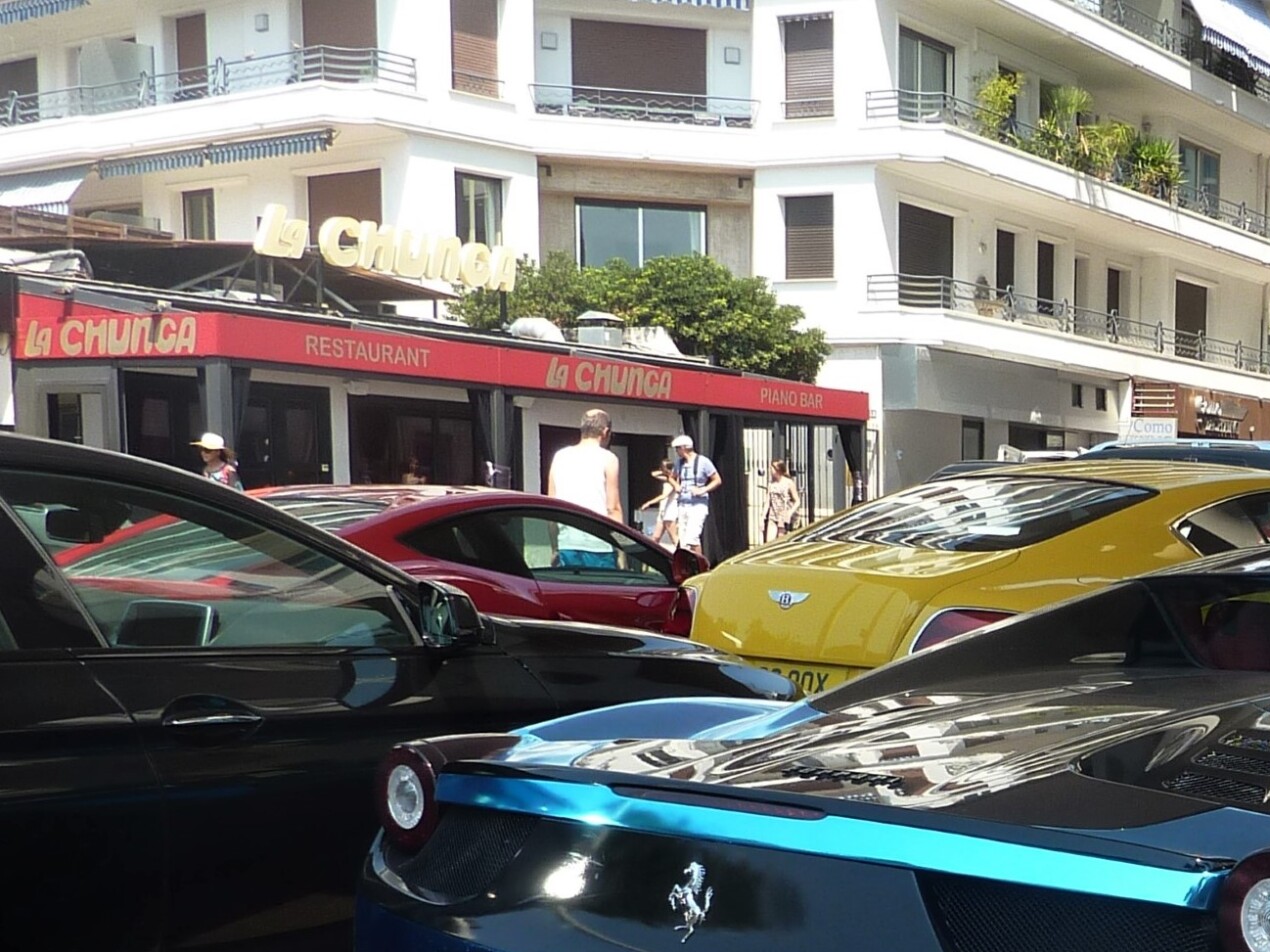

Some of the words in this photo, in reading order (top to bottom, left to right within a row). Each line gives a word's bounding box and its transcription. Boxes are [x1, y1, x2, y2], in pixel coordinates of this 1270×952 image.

[305, 334, 431, 368] RESTAURANT
[760, 387, 798, 408] PIANO
[800, 391, 824, 410] BAR
[1133, 418, 1173, 433] Como
